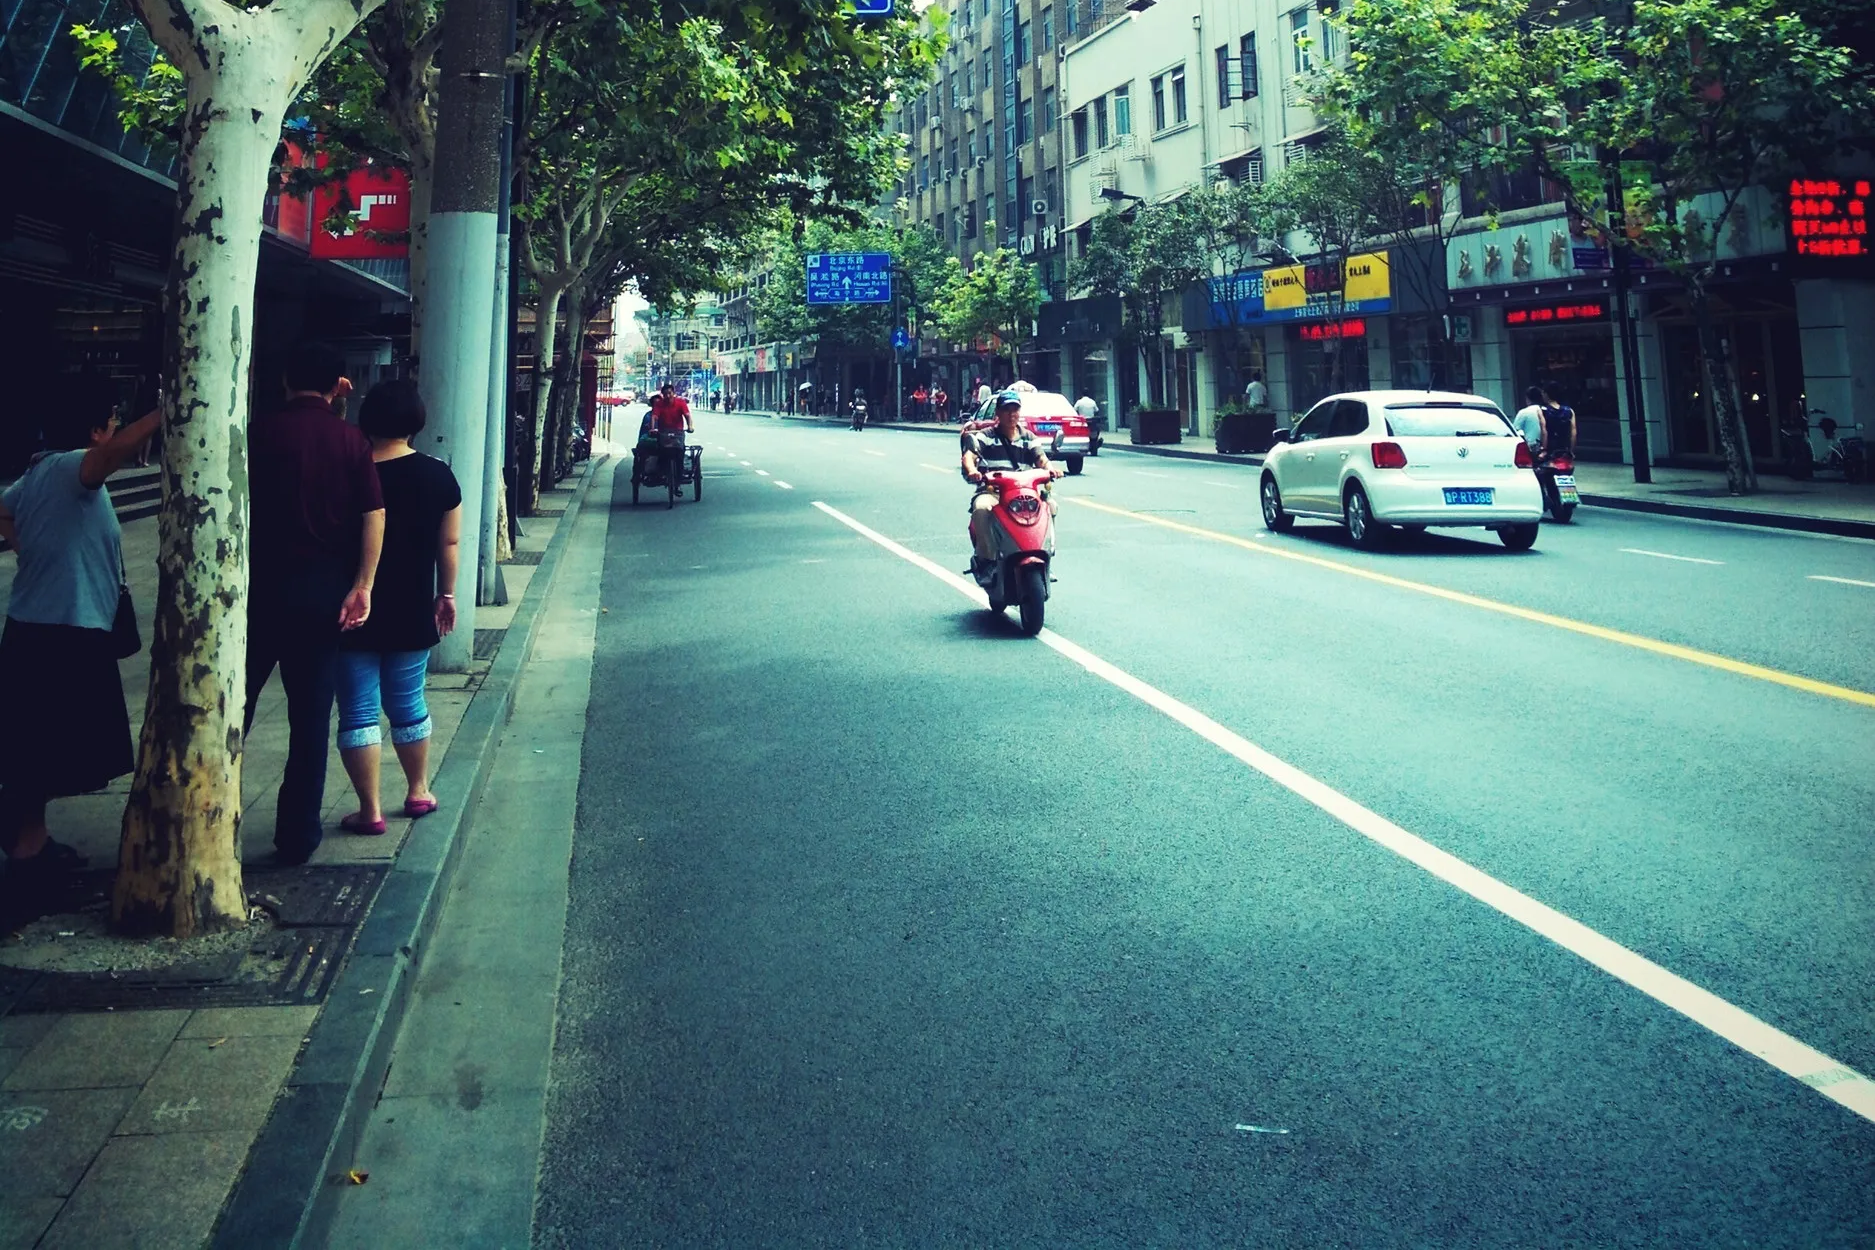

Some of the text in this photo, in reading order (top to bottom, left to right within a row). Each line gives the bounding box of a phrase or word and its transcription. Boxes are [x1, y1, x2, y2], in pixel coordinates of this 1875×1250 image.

[829, 256, 864, 265] 北京东路
[854, 271, 888, 280] 河南北路
